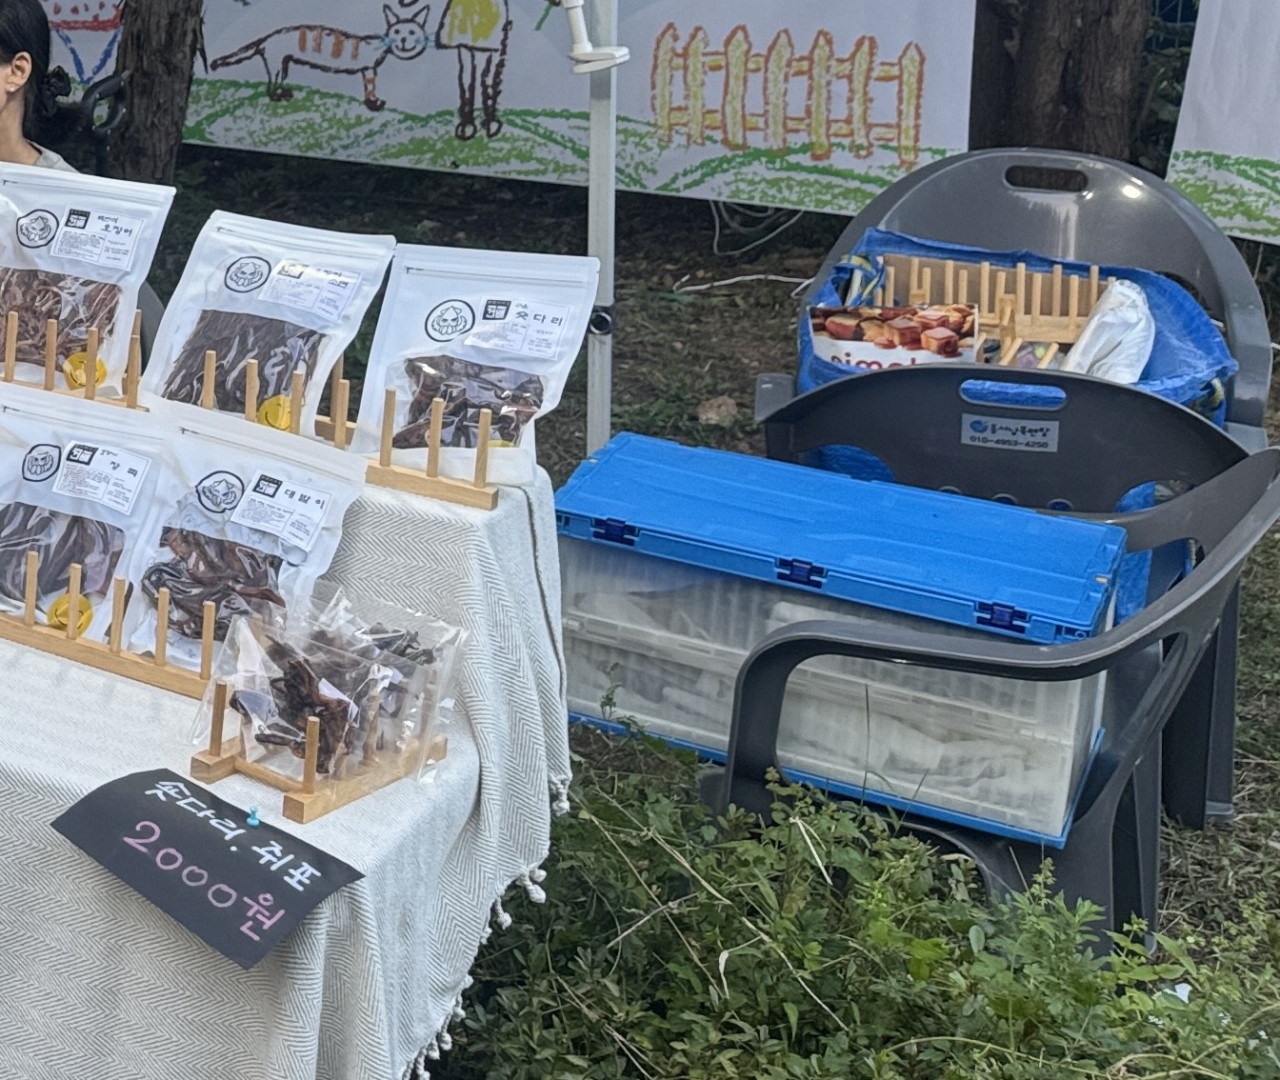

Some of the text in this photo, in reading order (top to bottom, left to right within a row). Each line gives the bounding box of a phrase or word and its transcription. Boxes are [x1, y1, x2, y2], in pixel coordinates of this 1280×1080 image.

[101, 224, 133, 236] 오징어
[122, 820, 286, 941] 2000원
[252, 841, 321, 892] 쥐포
